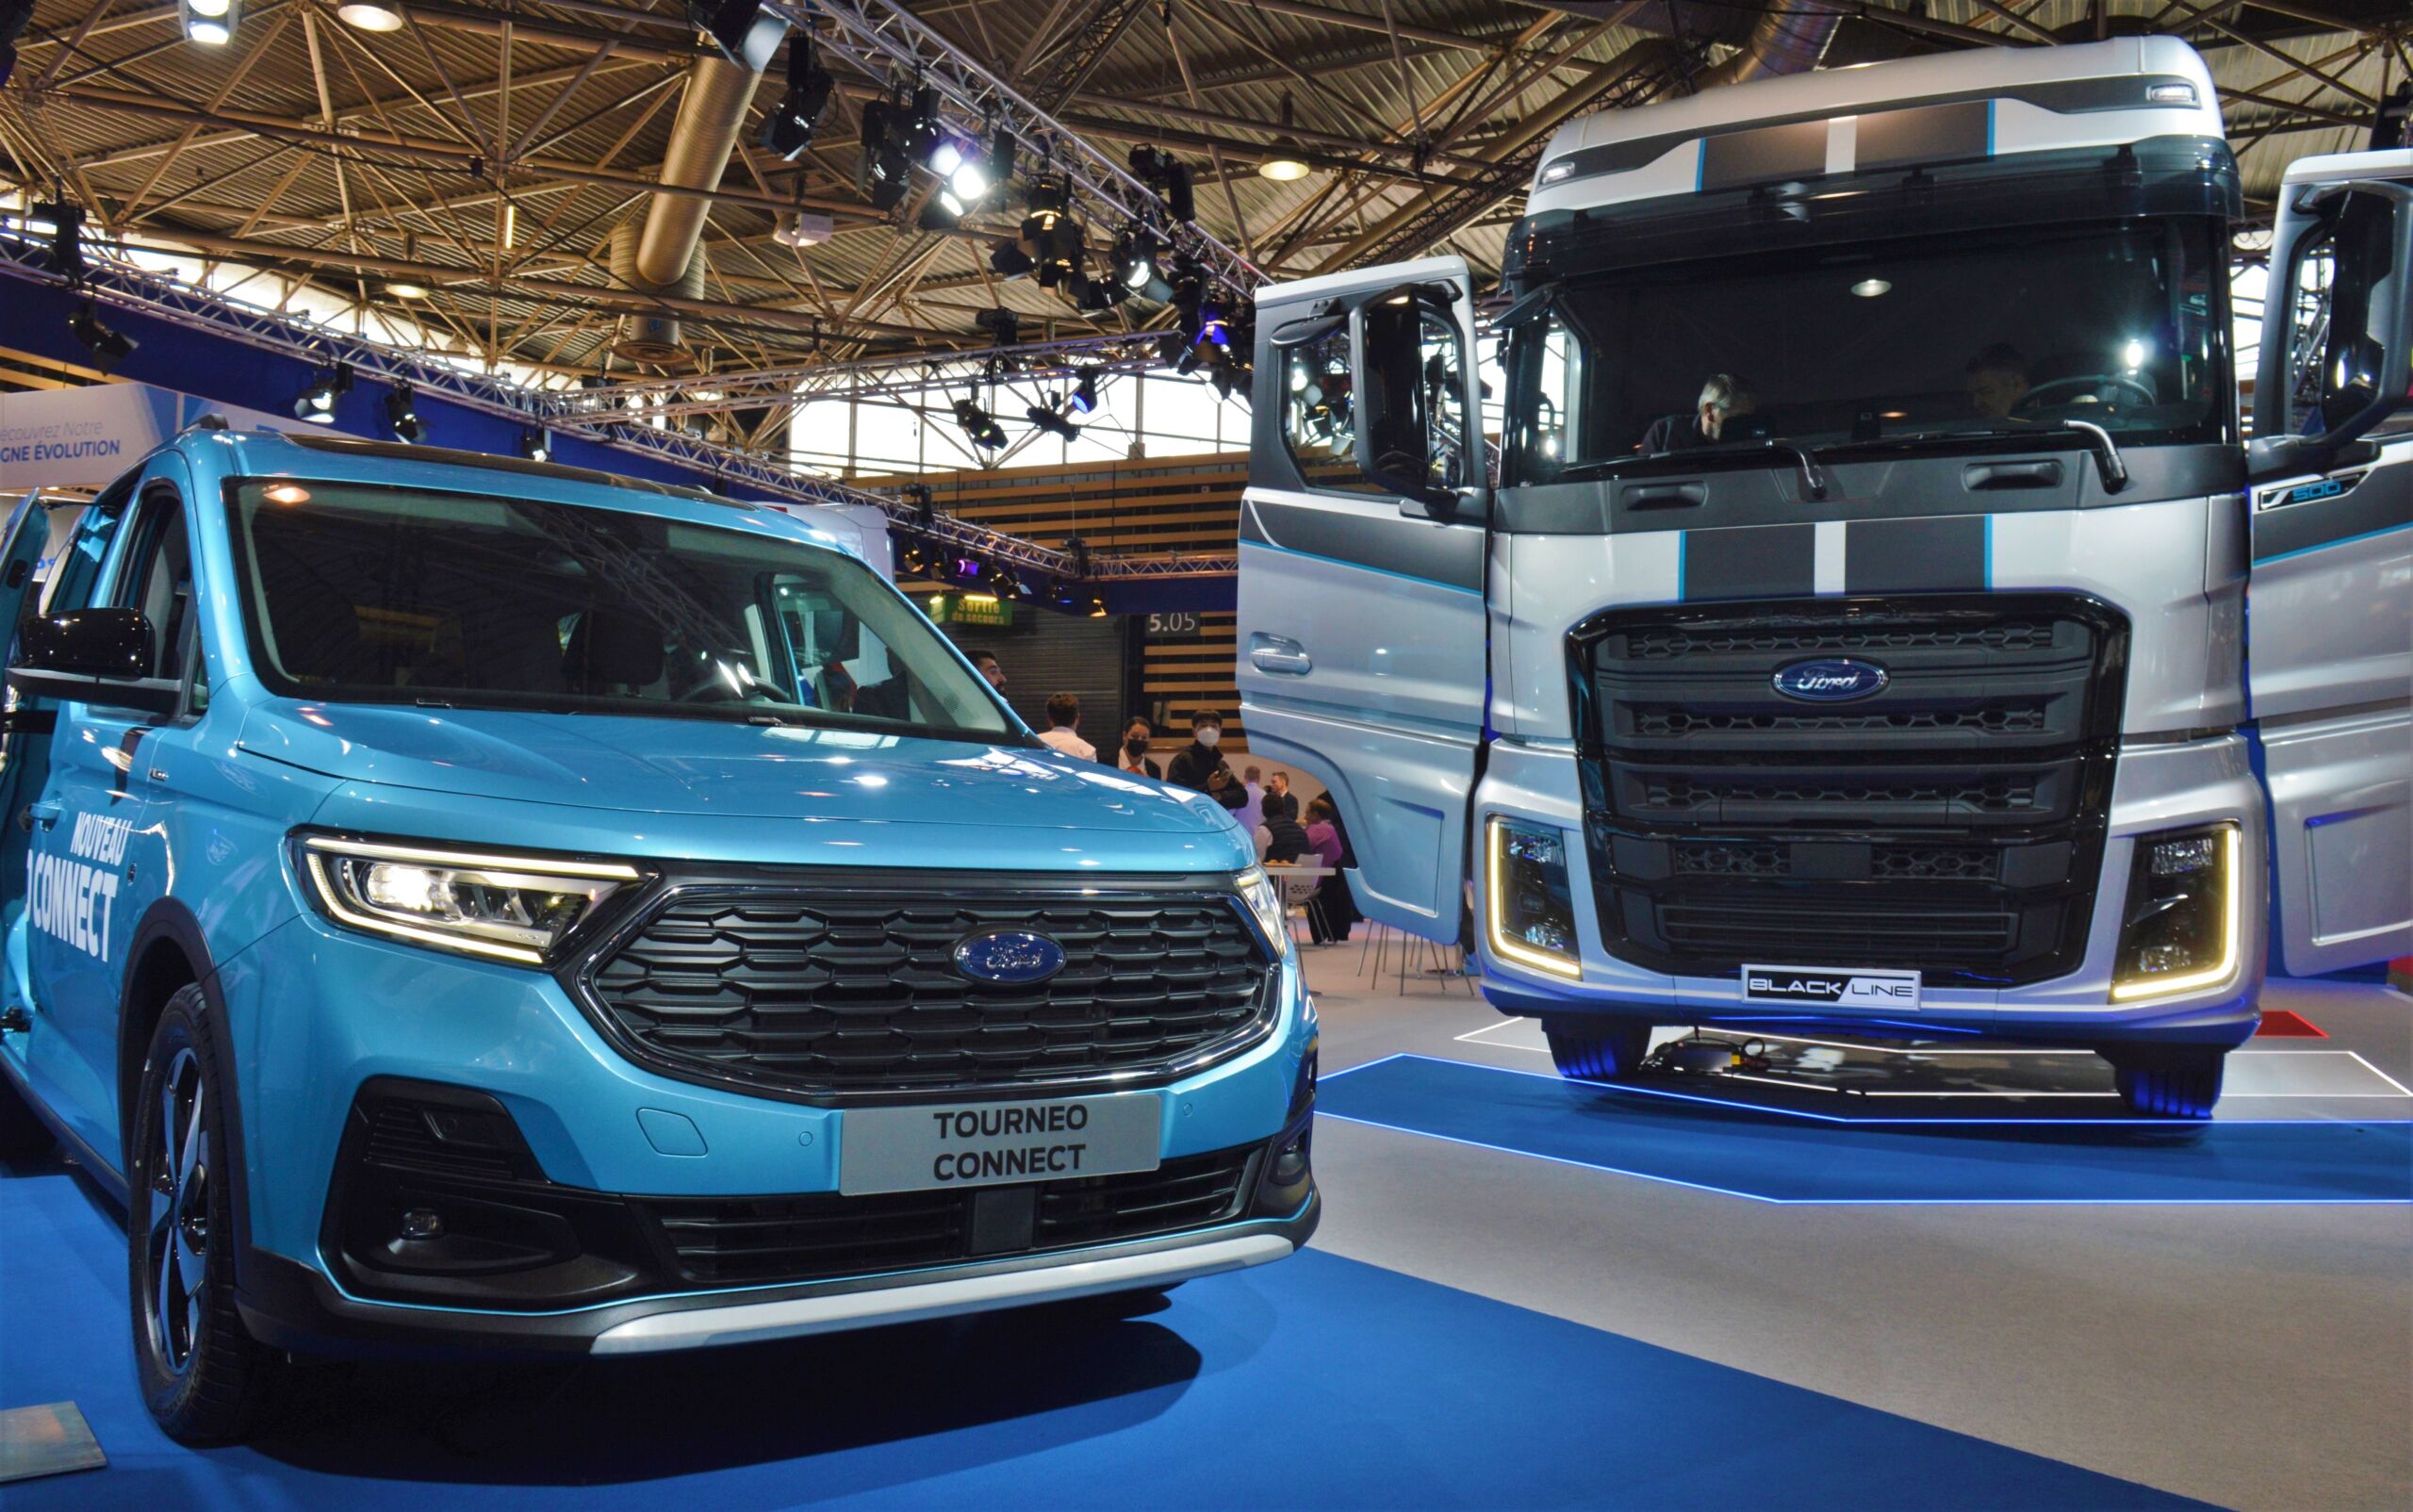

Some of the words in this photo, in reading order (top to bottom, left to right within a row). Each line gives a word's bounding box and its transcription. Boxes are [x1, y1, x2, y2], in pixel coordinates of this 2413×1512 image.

[63, 421, 103, 436] Notre
[34, 439, 120, 460] ÉVOLUTION
[2292, 482, 2340, 501] 500
[958, 598, 1000, 613] Sortie
[965, 613, 1005, 625] secours
[1149, 612, 1195, 632] 5.05
[1797, 666, 1861, 690] Ford
[70, 812, 132, 866] NOUVEAU
[34, 851, 119, 962] CONNECT
[1748, 978, 1842, 995] BLACK
[1851, 983, 1913, 997] LINE
[933, 1104, 1089, 1139] TOURNEO
[933, 1143, 1086, 1180] CONNECT
